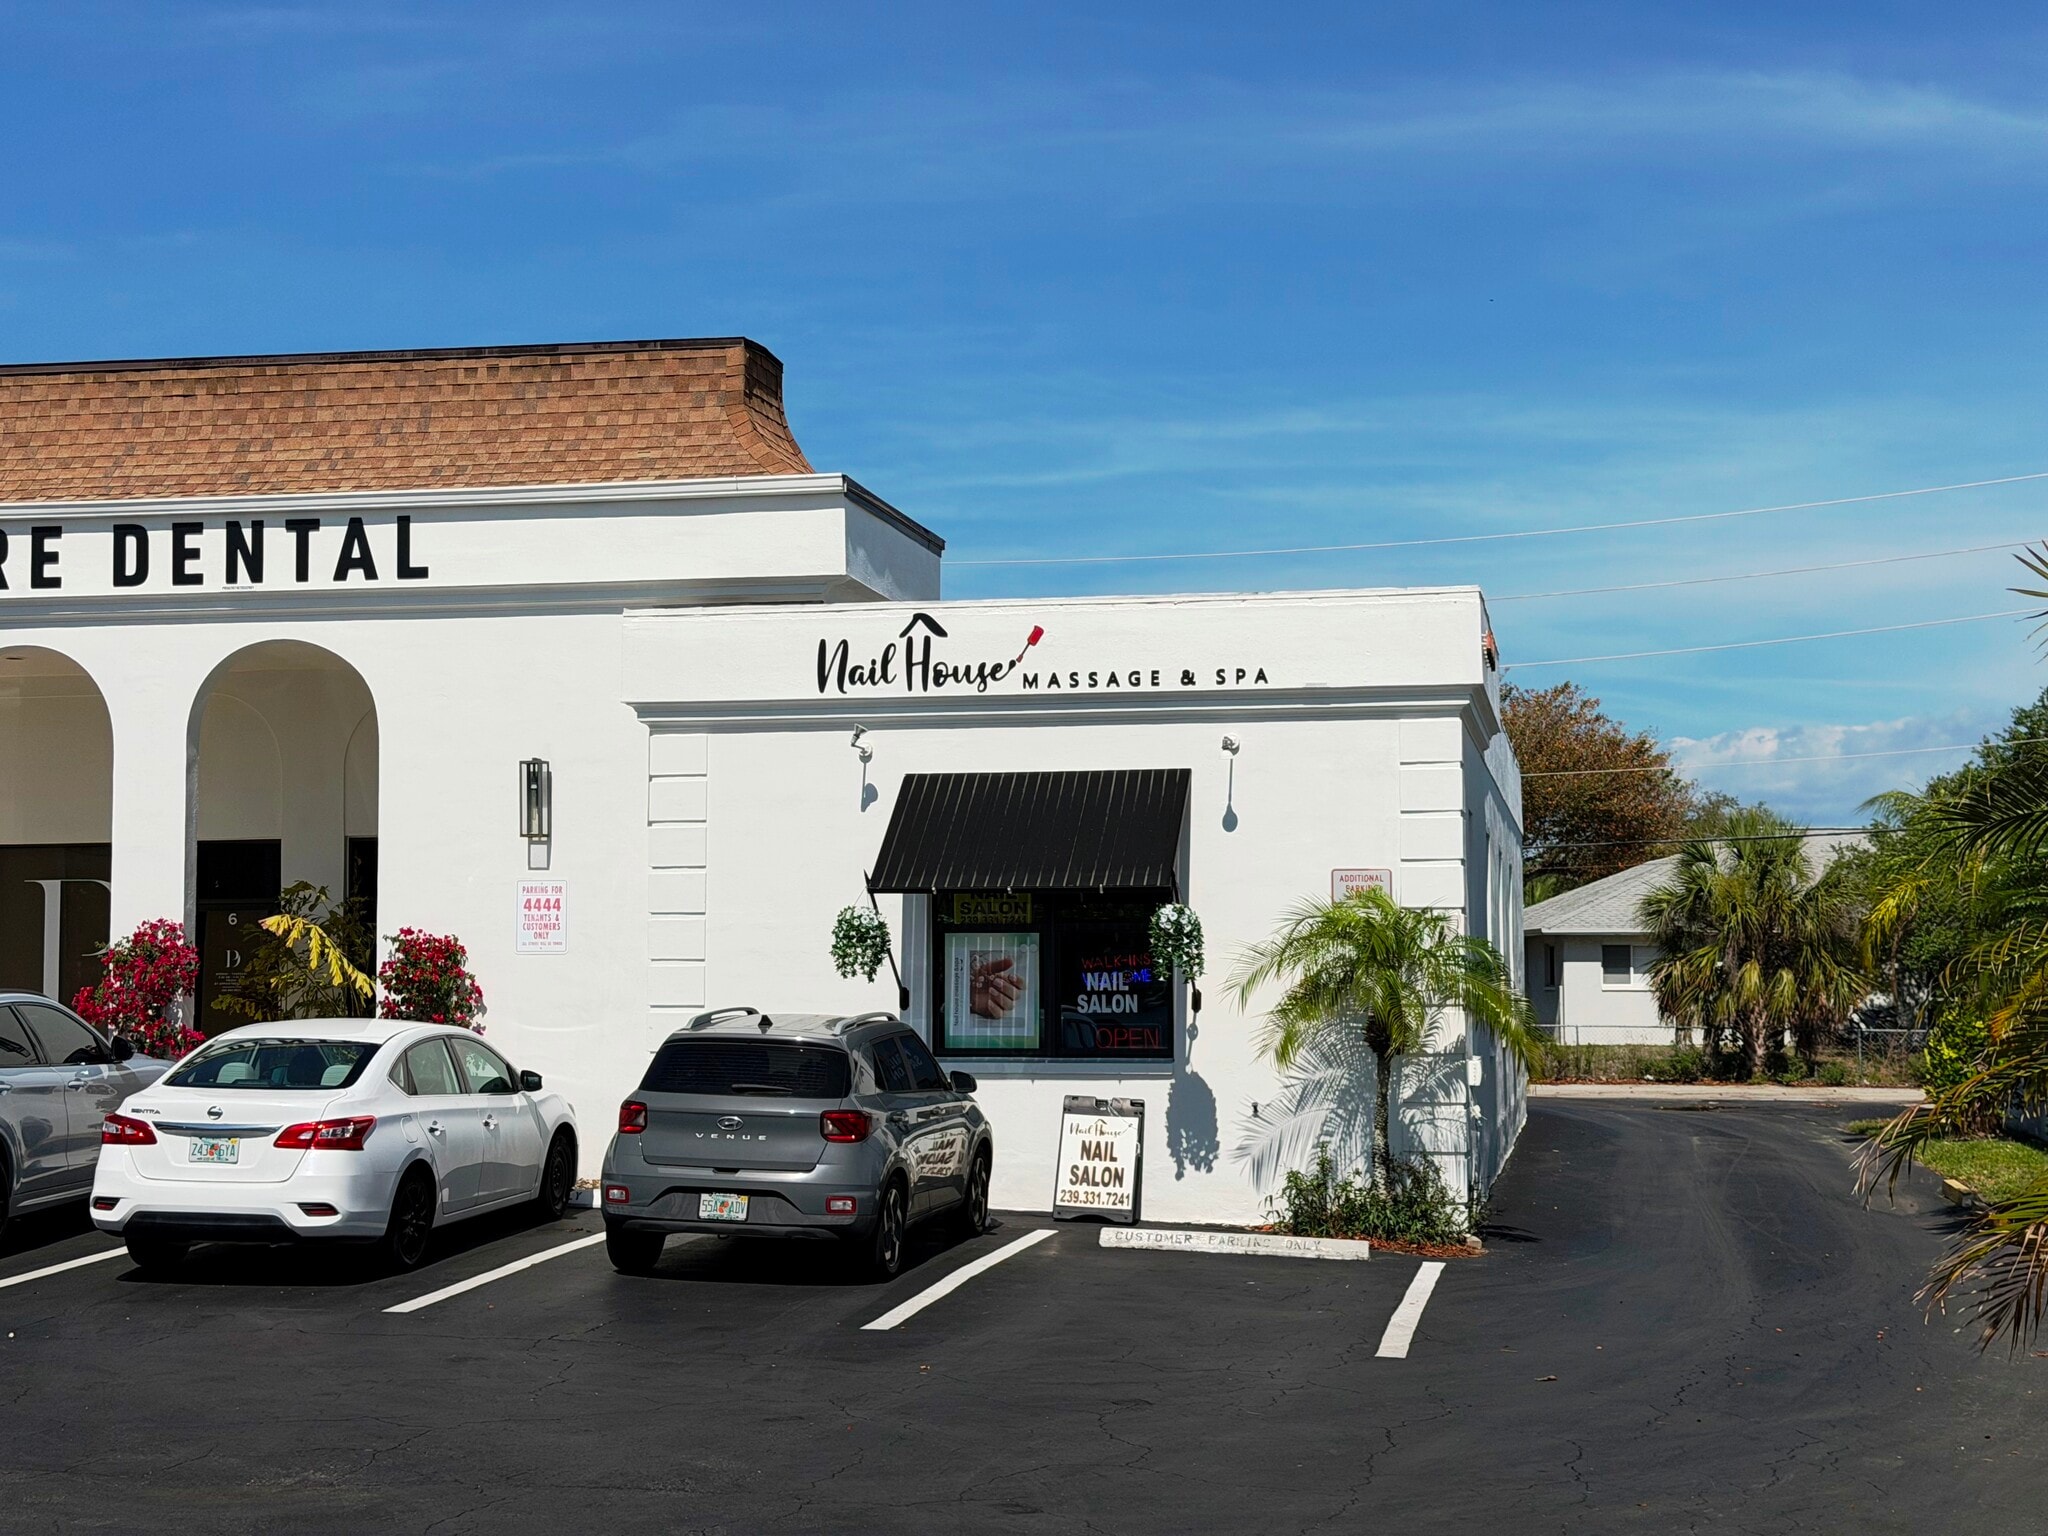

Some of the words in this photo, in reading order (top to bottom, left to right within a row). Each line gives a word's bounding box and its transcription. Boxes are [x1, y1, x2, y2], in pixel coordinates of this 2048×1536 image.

[0, 526, 63, 590] E
[112, 515, 429, 588] DENTAL
[816, 637, 897, 695] Nail
[903, 628, 1016, 693] House
[1022, 670, 1161, 690] MASSAGE
[1180, 668, 1196, 687] &
[1214, 666, 1270, 686] SPA
[1339, 874, 1384, 883] ADDITIONAL
[522, 885, 549, 894] PARKING
[551, 885, 563, 894] FOR
[523, 897, 562, 912] 4444
[960, 901, 1028, 915] SALON
[228, 912, 238, 926] 6
[523, 913, 552, 923] TENANTS
[554, 913, 560, 922] &
[522, 922, 561, 931] CUSTOMERS
[533, 931, 550, 940] ONLY
[1081, 953, 1152, 969] WALK-INS
[1086, 971, 1130, 992] NAIL
[1076, 993, 1139, 1014] SALON
[1095, 1026, 1161, 1050] OPEN
[1069, 1121, 1093, 1136] Nail
[695, 1132, 767, 1142] VENUE
[191, 1143, 209, 1157] Z43
[1080, 1139, 1118, 1163] NAIL
[1068, 1163, 1125, 1189] SALON
[1059, 1188, 1131, 1207] 239.331.7241
[1115, 1230, 1193, 1245] CUSTOMER
